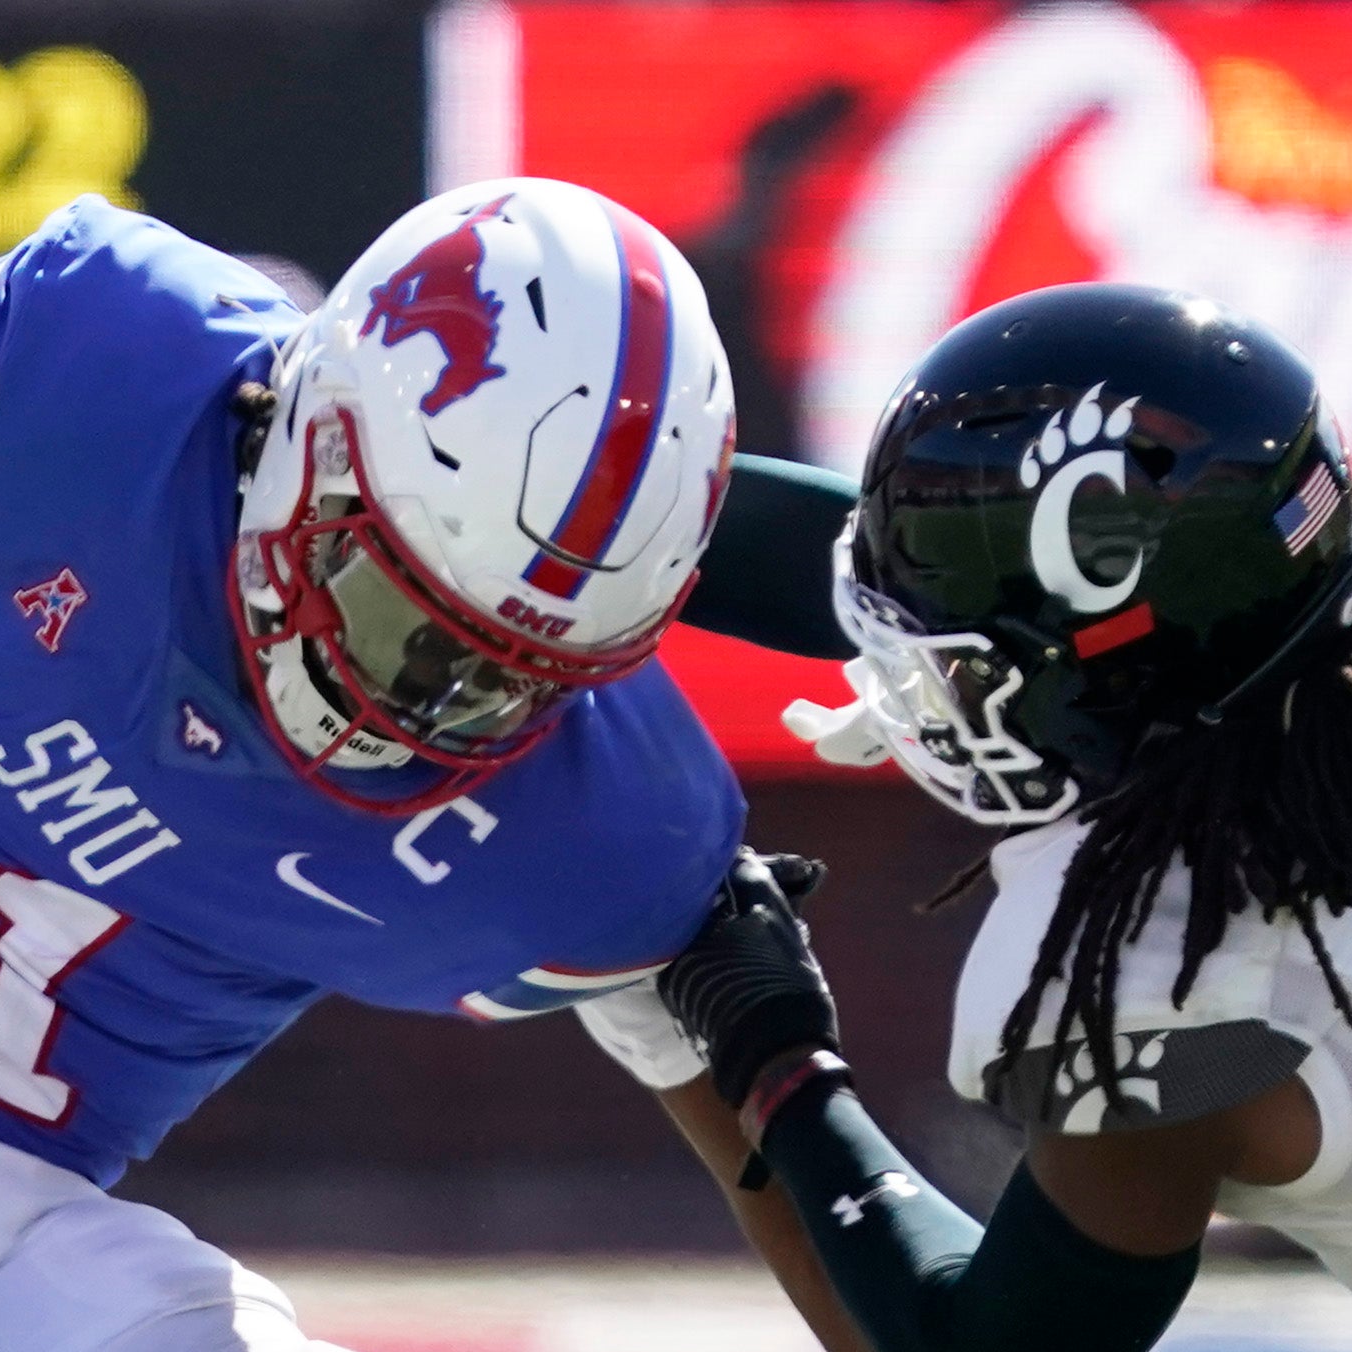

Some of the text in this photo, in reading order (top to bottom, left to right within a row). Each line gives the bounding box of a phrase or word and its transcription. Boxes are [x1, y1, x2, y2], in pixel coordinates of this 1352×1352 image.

[496, 595, 575, 639] SMU
[318, 713, 388, 757] Ridell
[393, 795, 499, 885] C
